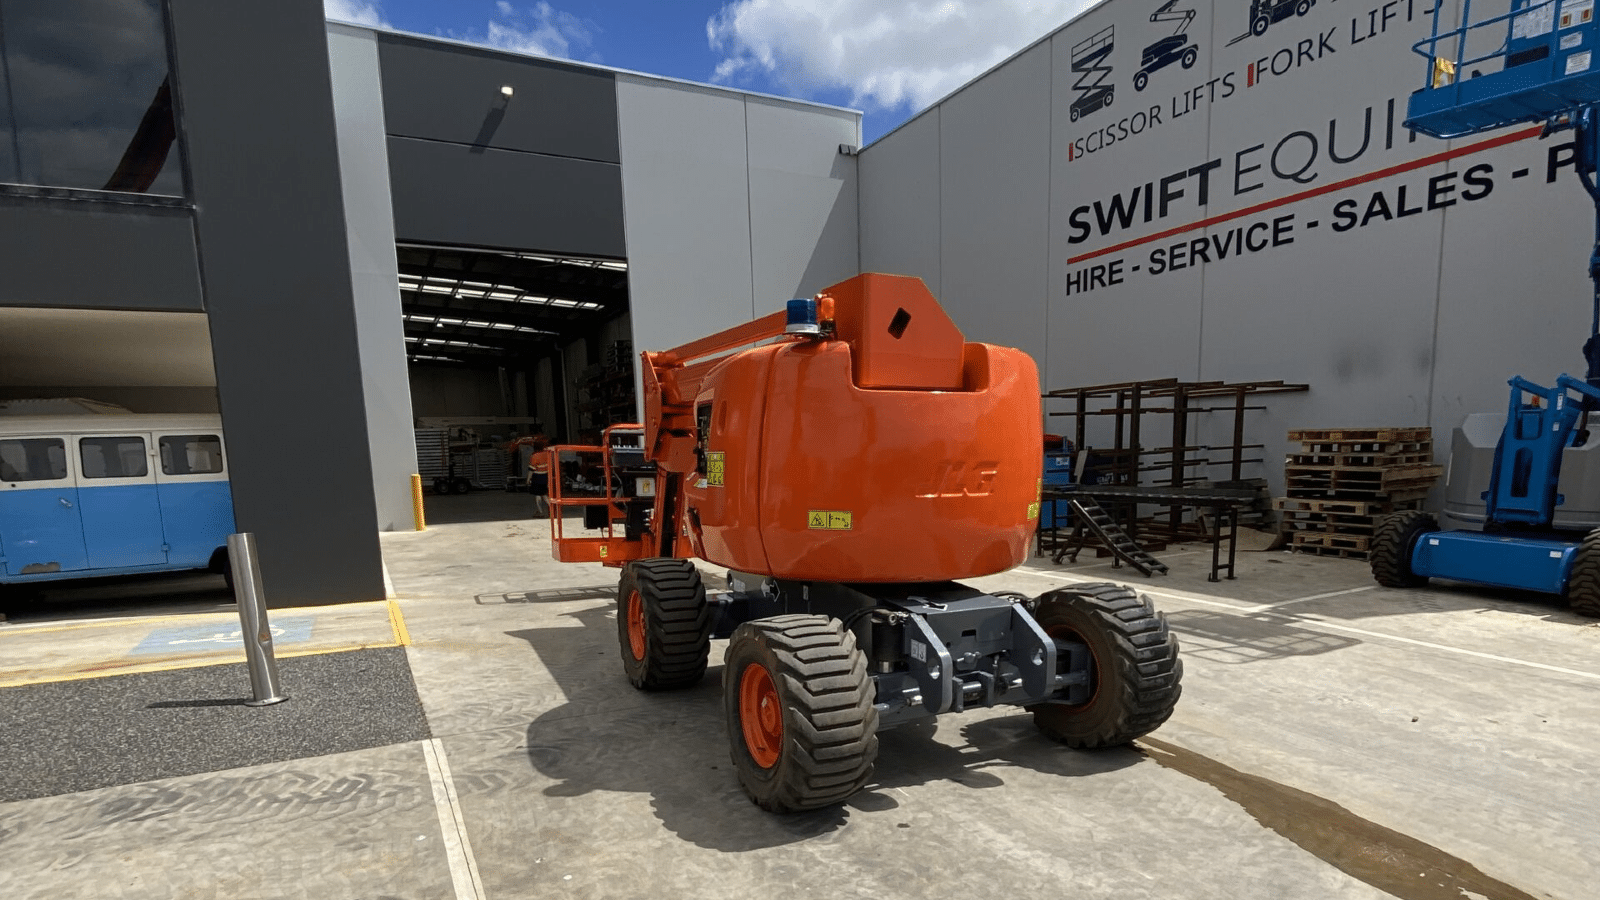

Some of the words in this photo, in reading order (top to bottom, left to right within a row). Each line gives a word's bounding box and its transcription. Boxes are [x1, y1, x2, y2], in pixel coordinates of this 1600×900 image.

[1256, 27, 1337, 84] FORK
[1067, 159, 1221, 244] SWIFT
[1234, 98, 1416, 196] EQUI
[1074, 104, 1162, 160] SCISSOR
[1171, 72, 1235, 119] LIFTS
[1066, 259, 1124, 296] HIRE
[1148, 214, 1295, 276] SERVICE
[1331, 163, 1494, 233] SALES
